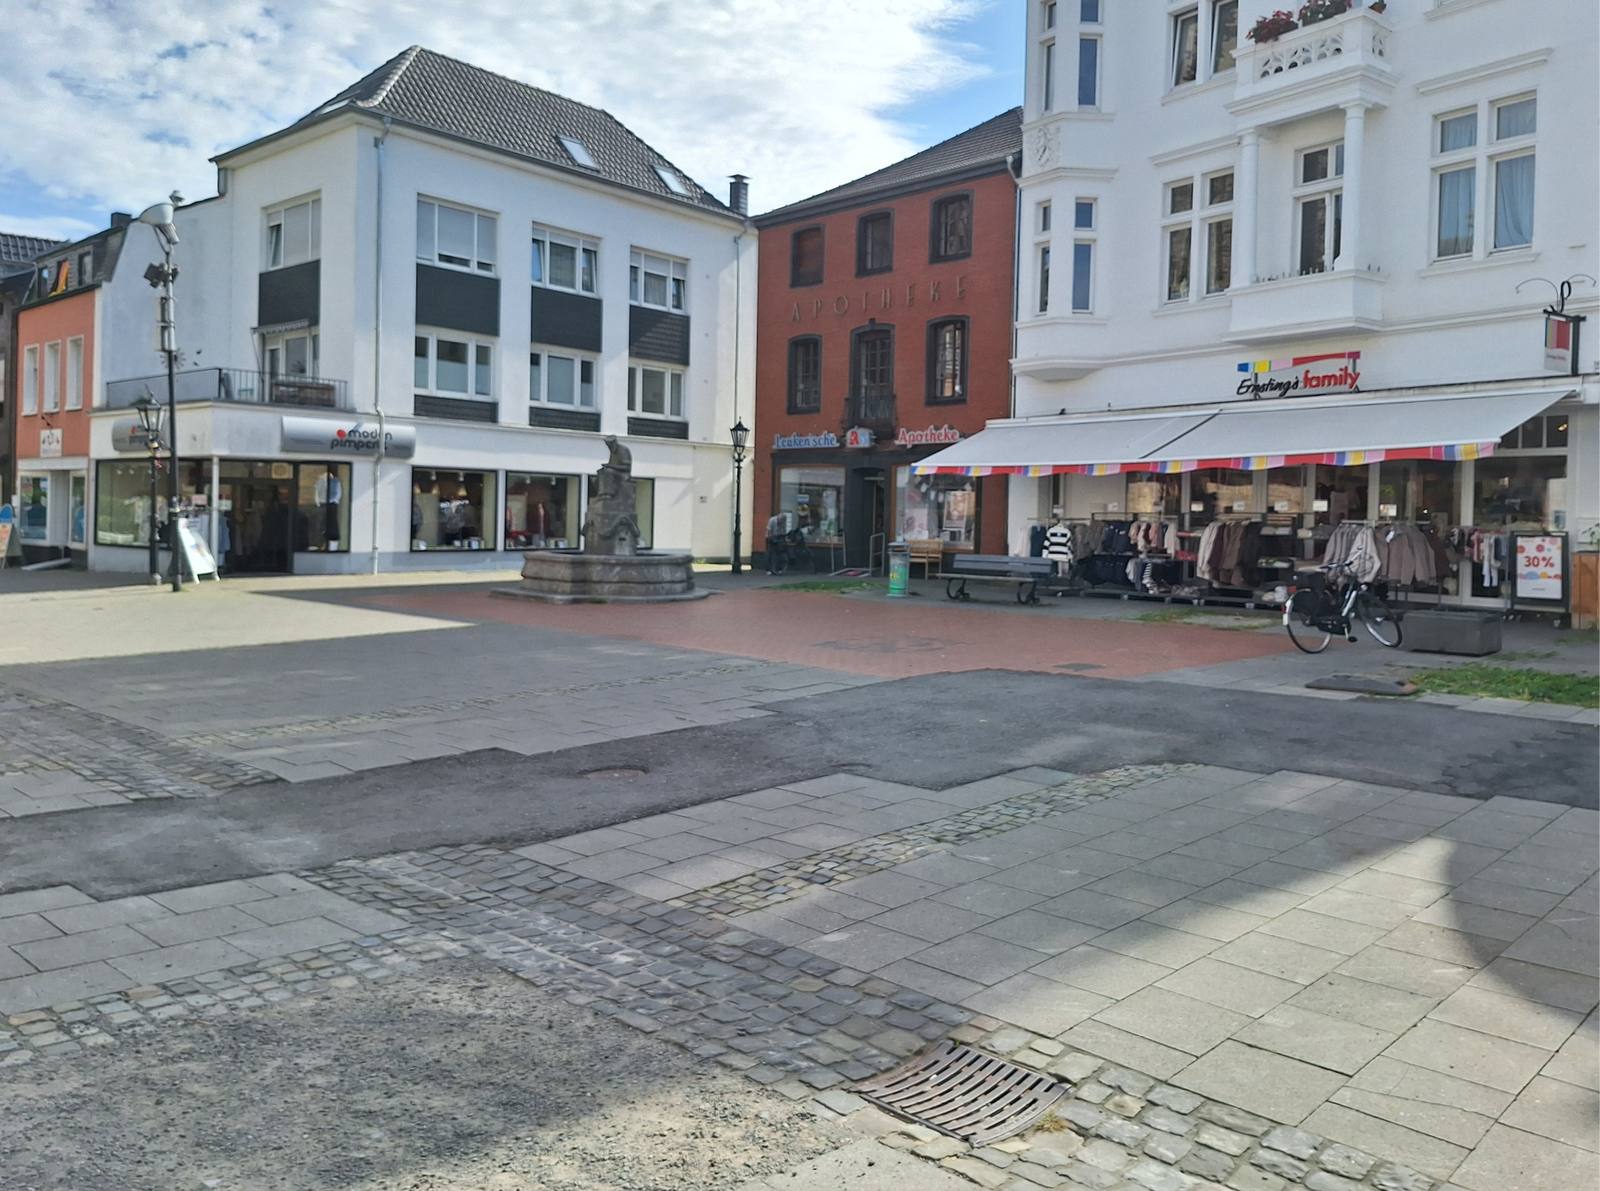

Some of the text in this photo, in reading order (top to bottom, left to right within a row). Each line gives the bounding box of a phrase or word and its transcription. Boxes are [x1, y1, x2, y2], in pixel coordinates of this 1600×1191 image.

[792, 275, 966, 322] APOTHEKE
[1236, 366, 1360, 397] Ernsting's family
[899, 425, 959, 447] Apotheke
[1524, 555, 1555, 568] 30%
